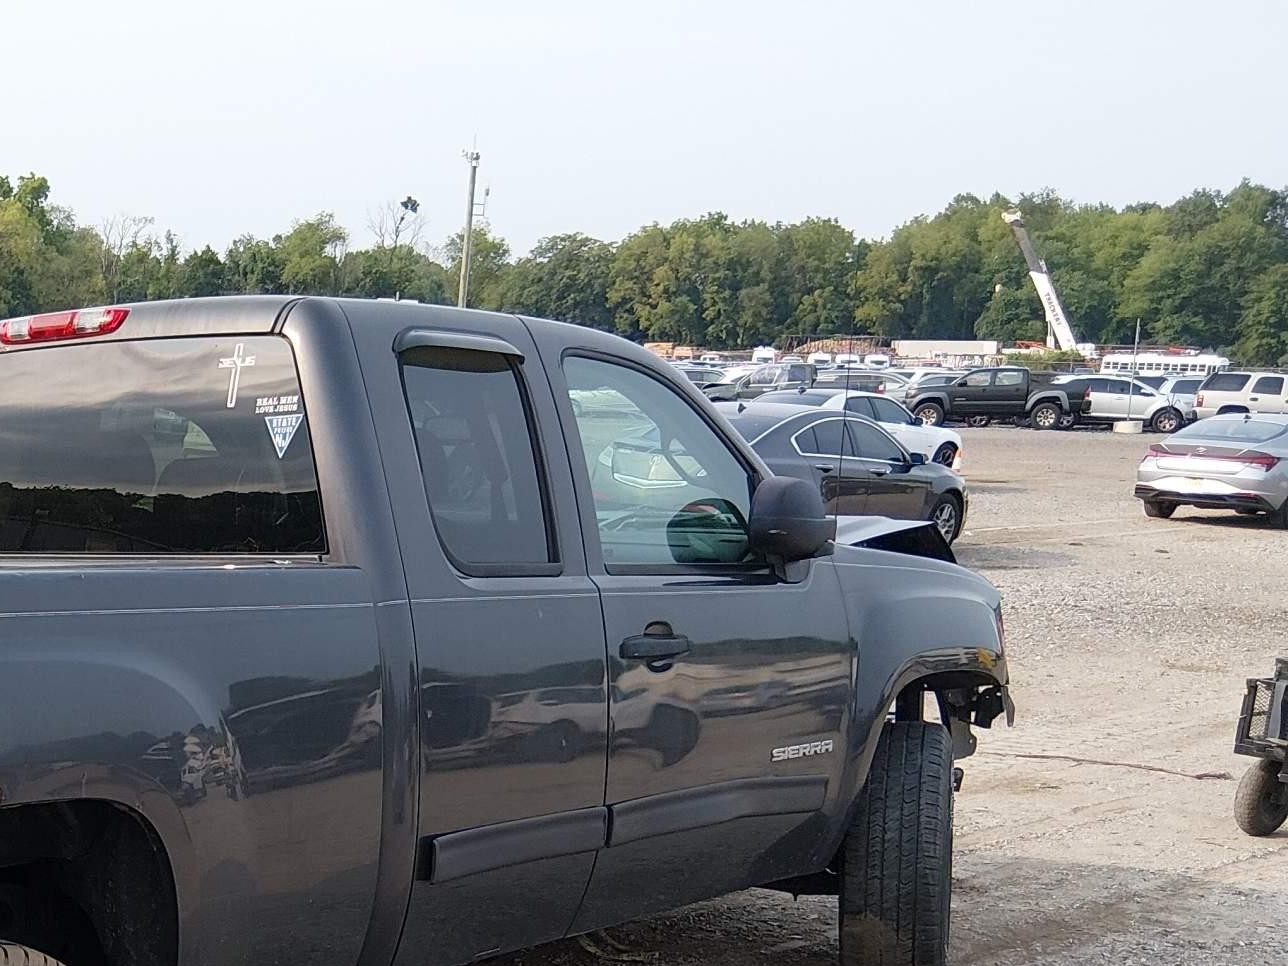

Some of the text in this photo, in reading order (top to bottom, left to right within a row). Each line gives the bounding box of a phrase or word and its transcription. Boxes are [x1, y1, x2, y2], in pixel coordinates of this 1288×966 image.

[256, 395, 299, 407] REAL MEN
[255, 403, 298, 414] LOVE JESUS
[272, 417, 297, 428] STATE
[772, 739, 833, 762] SIERRA
